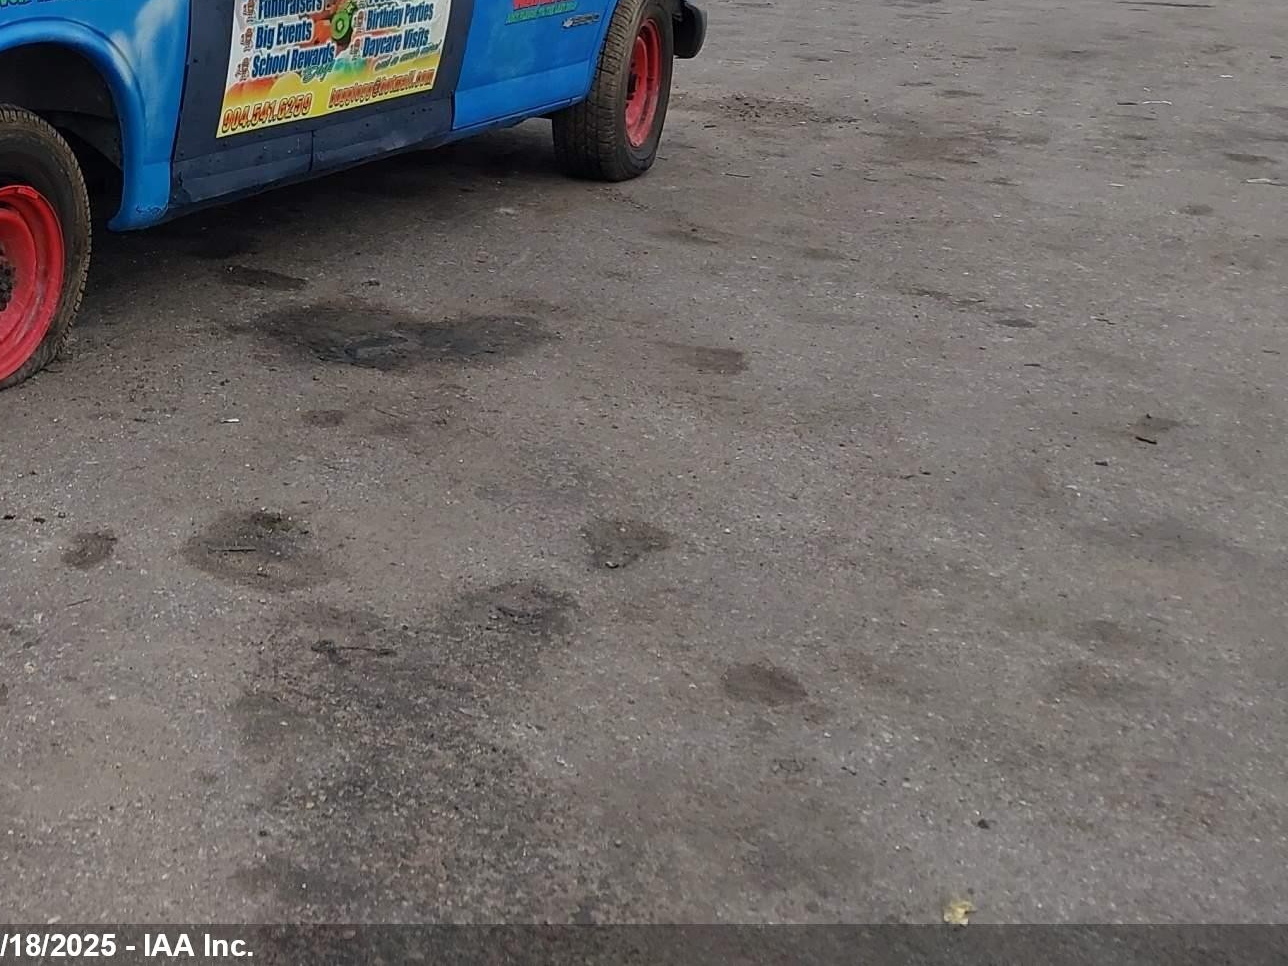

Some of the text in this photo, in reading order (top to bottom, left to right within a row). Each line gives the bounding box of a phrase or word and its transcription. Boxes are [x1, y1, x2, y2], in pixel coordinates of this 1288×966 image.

[366, 0, 434, 31] Birthday Parties
[255, 20, 312, 50] Big Events
[363, 27, 430, 58] Daycare Visits
[252, 53, 290, 78] School
[292, 44, 336, 71] Rewards
[221, 92, 313, 133] 904.541.6259
